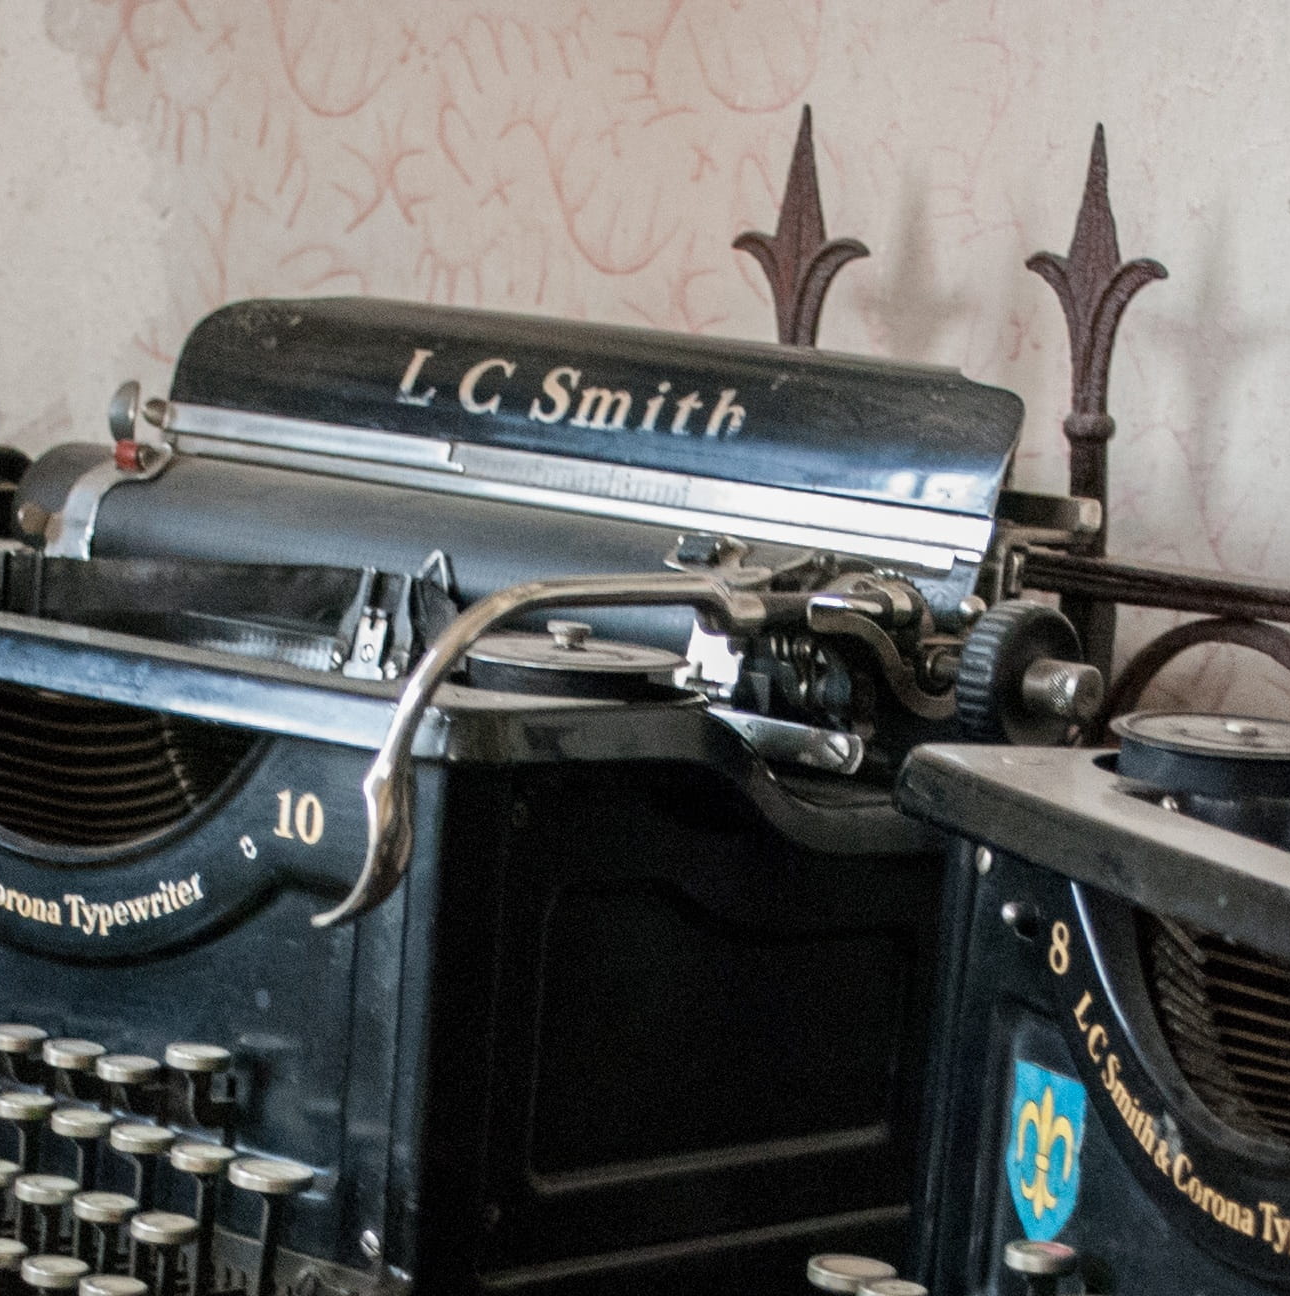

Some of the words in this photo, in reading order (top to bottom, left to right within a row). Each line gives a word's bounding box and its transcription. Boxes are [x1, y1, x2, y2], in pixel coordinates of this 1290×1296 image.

[397, 348, 436, 407] L
[458, 357, 517, 416] C
[528, 365, 747, 438] Smith
[273, 789, 325, 845] 10
[63, 870, 205, 936] Typewriter
[1048, 921, 1070, 976] 8
[1073, 989, 1093, 1032] L
[1087, 1023, 1108, 1064] C
[1101, 1053, 1157, 1156] Smith
[1154, 1139, 1172, 1176] &
[1173, 1153, 1255, 1238] Corona
